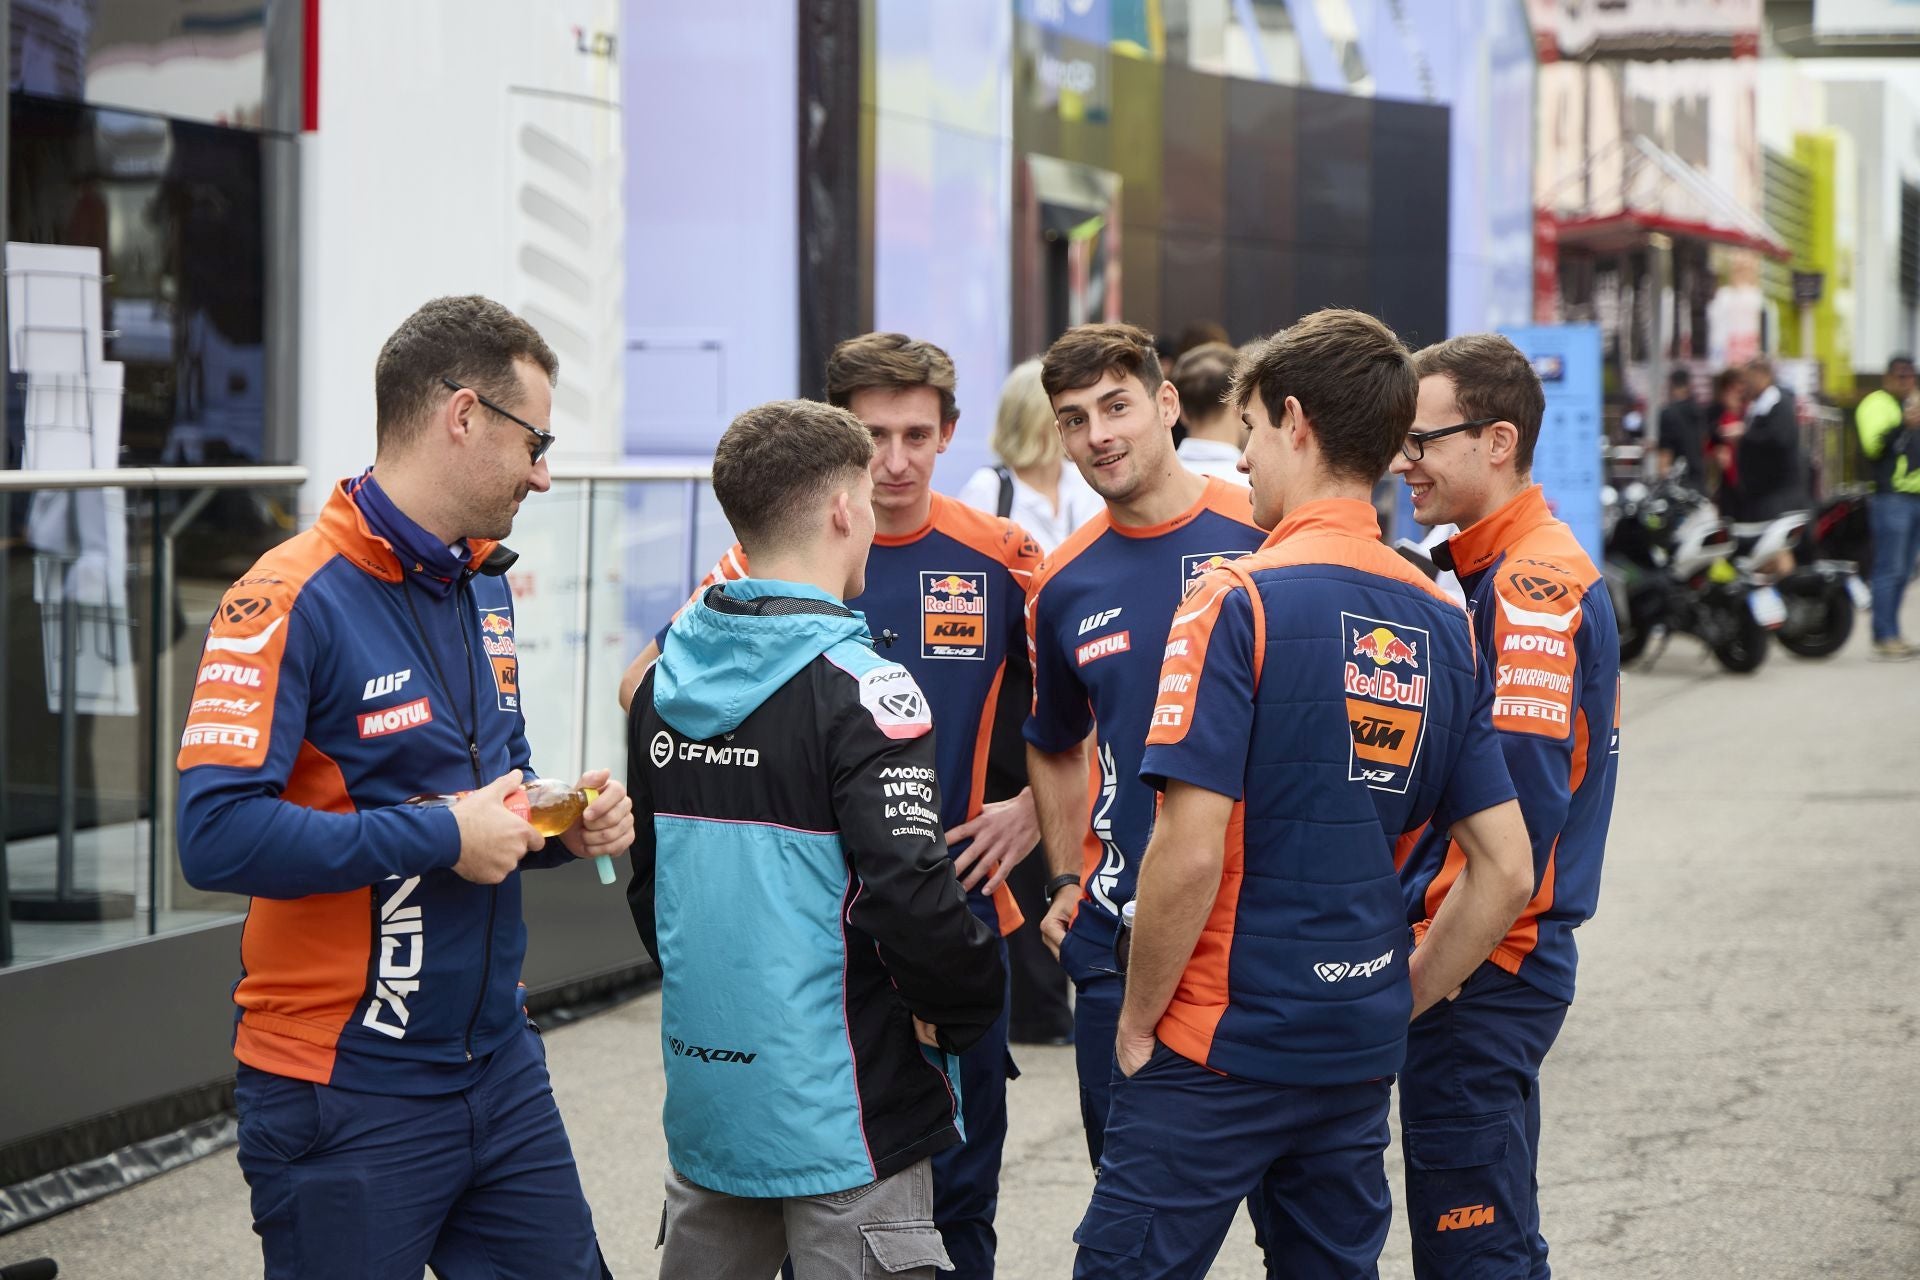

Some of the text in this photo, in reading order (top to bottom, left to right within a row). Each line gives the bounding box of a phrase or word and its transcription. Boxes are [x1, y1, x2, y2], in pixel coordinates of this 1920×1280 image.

[925, 595, 984, 614] Red Bull
[933, 621, 976, 637] KTM
[1078, 607, 1122, 636] WP
[1078, 635, 1127, 665] MOTUL
[1503, 634, 1567, 657] MOTUL
[198, 663, 262, 688] MOTUL
[362, 669, 412, 701] WP
[502, 666, 515, 685] KT
[1345, 661, 1426, 708] Red Bull
[363, 702, 429, 735] MOTUL
[1493, 696, 1567, 724] PIRELLI
[181, 722, 260, 749] PIRELLI
[1350, 716, 1405, 750] KTM
[679, 742, 760, 767] CFMOTO
[883, 782, 932, 803] IVECO
[1437, 1204, 1495, 1232] KTM
